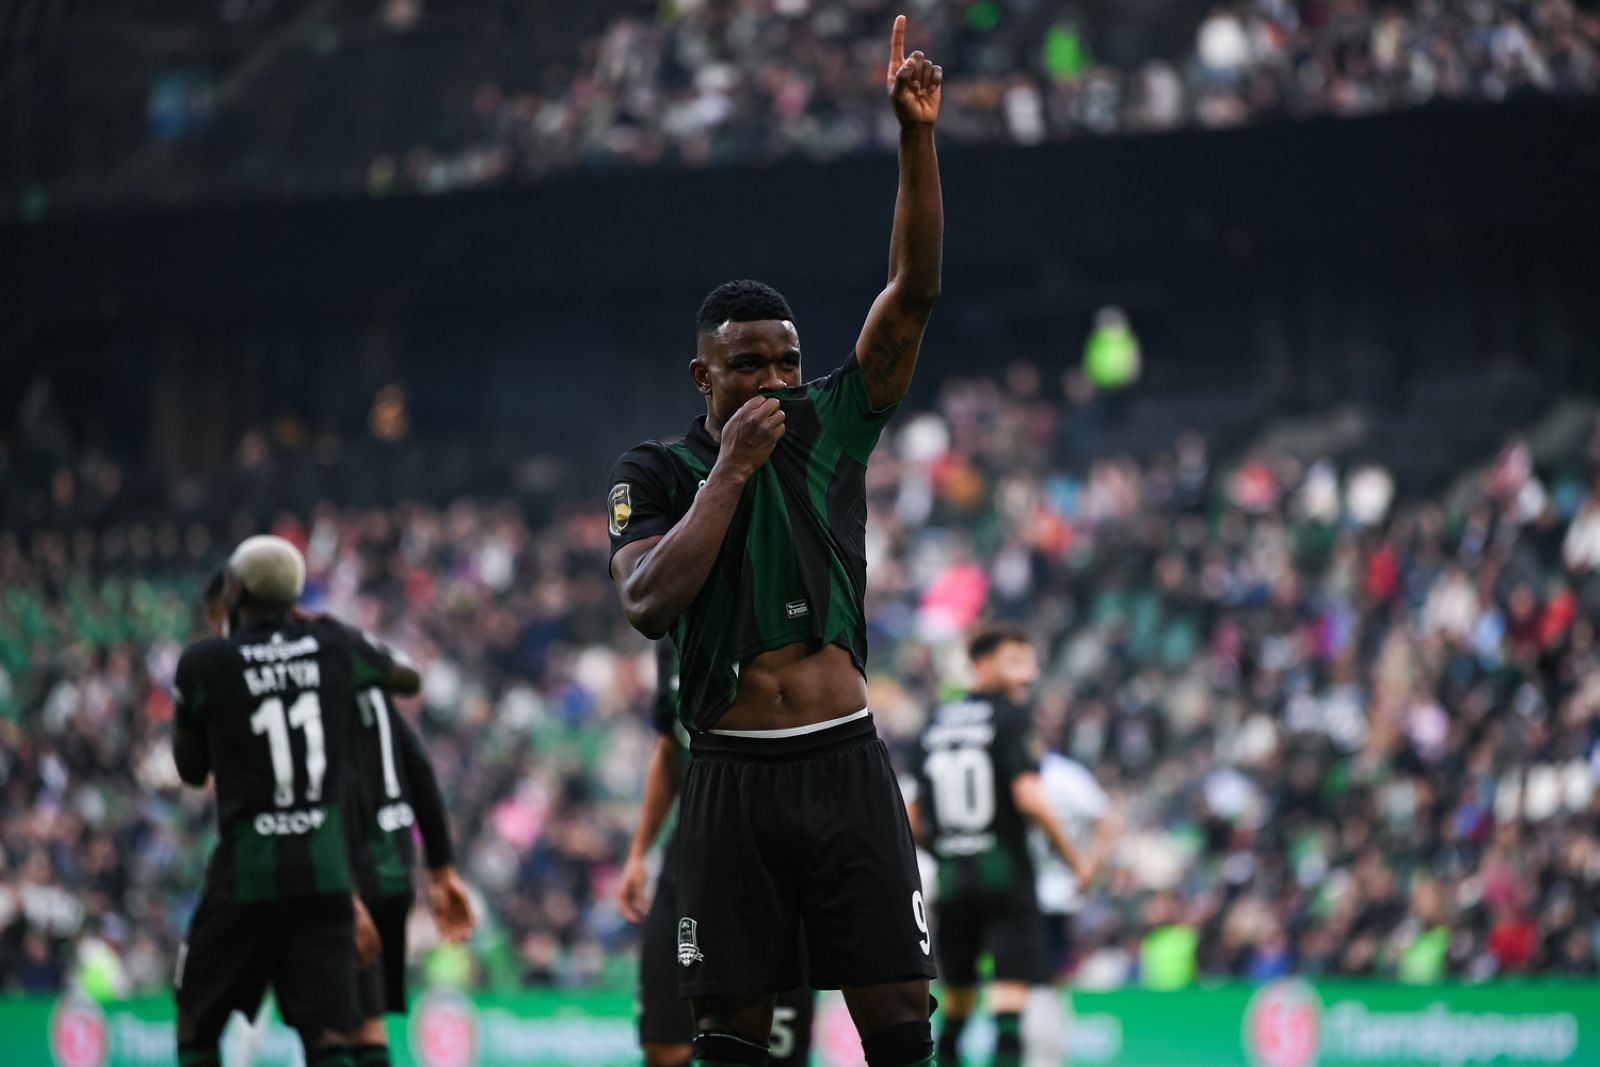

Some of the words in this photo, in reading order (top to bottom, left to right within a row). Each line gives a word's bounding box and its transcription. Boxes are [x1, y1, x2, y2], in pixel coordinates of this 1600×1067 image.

[250, 691, 327, 808] 11
[923, 748, 997, 831] 10
[912, 890, 931, 956] 9
